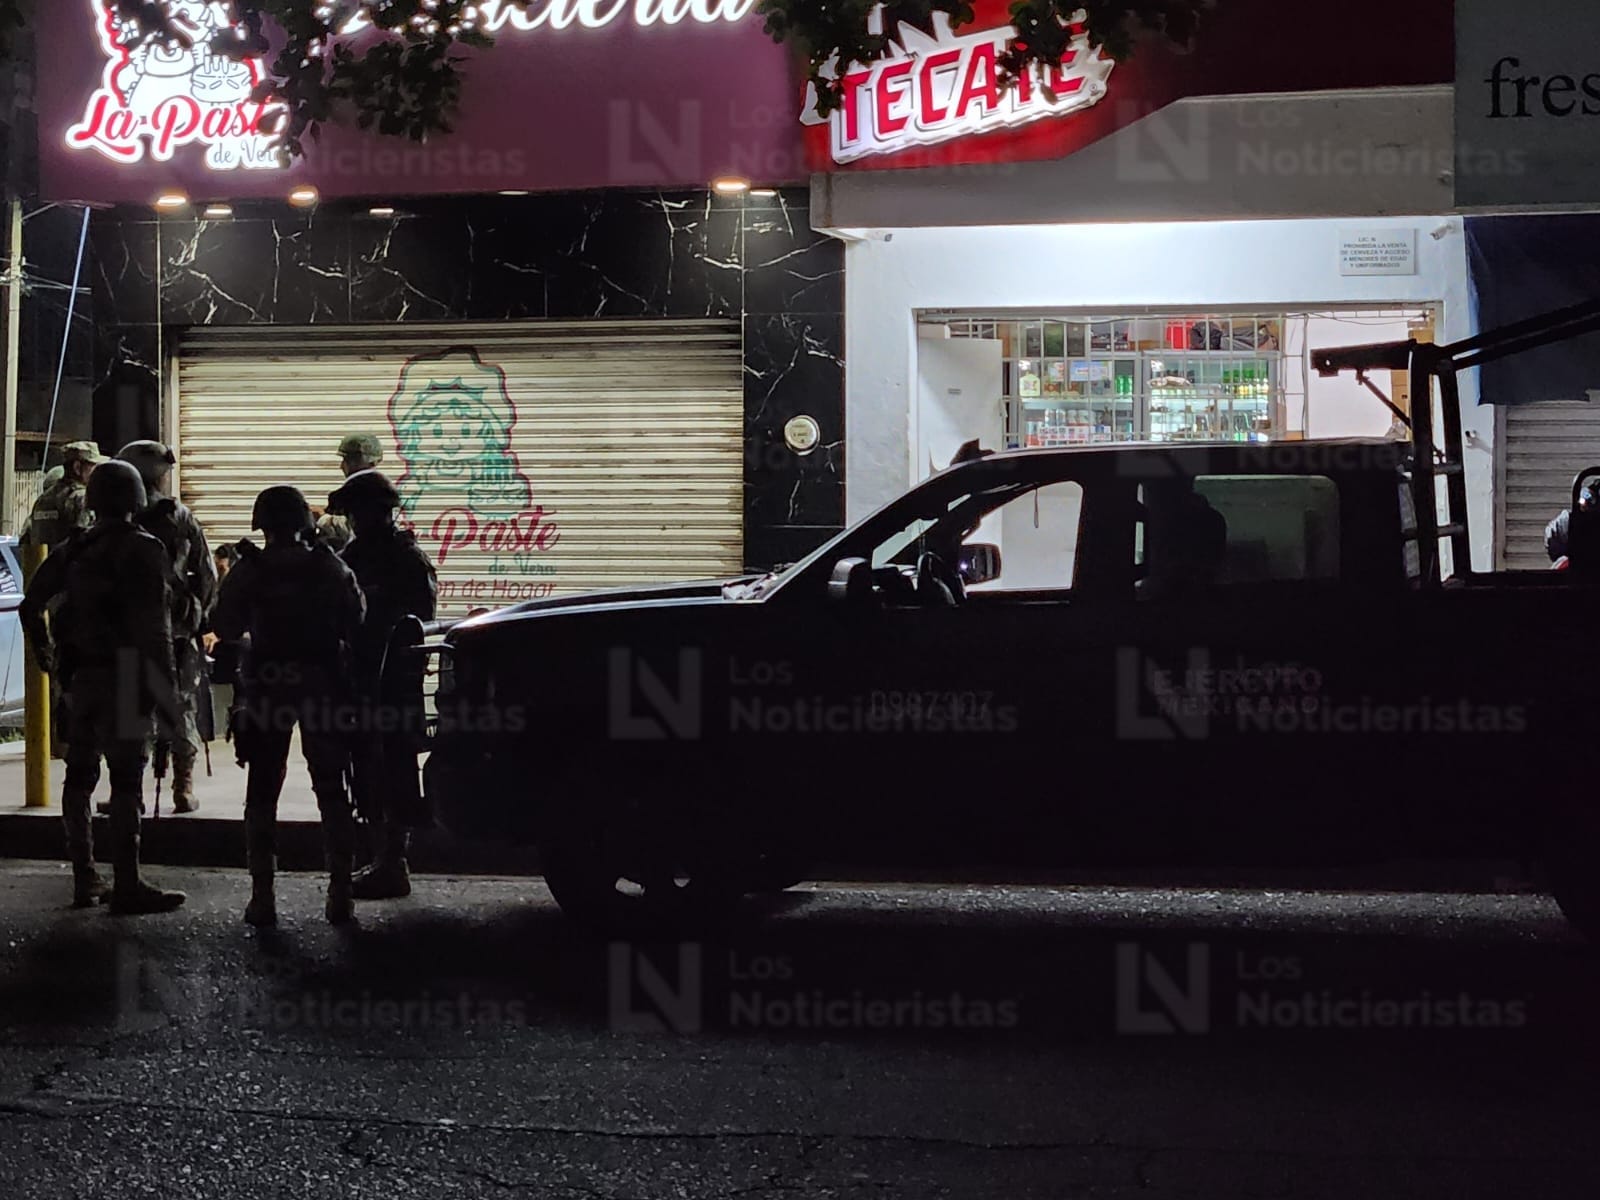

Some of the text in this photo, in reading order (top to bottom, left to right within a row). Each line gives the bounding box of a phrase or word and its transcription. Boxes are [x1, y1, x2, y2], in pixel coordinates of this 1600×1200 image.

[1484, 57, 1600, 118] fres
[461, 579, 487, 598] de
[491, 579, 557, 600] Hogar
